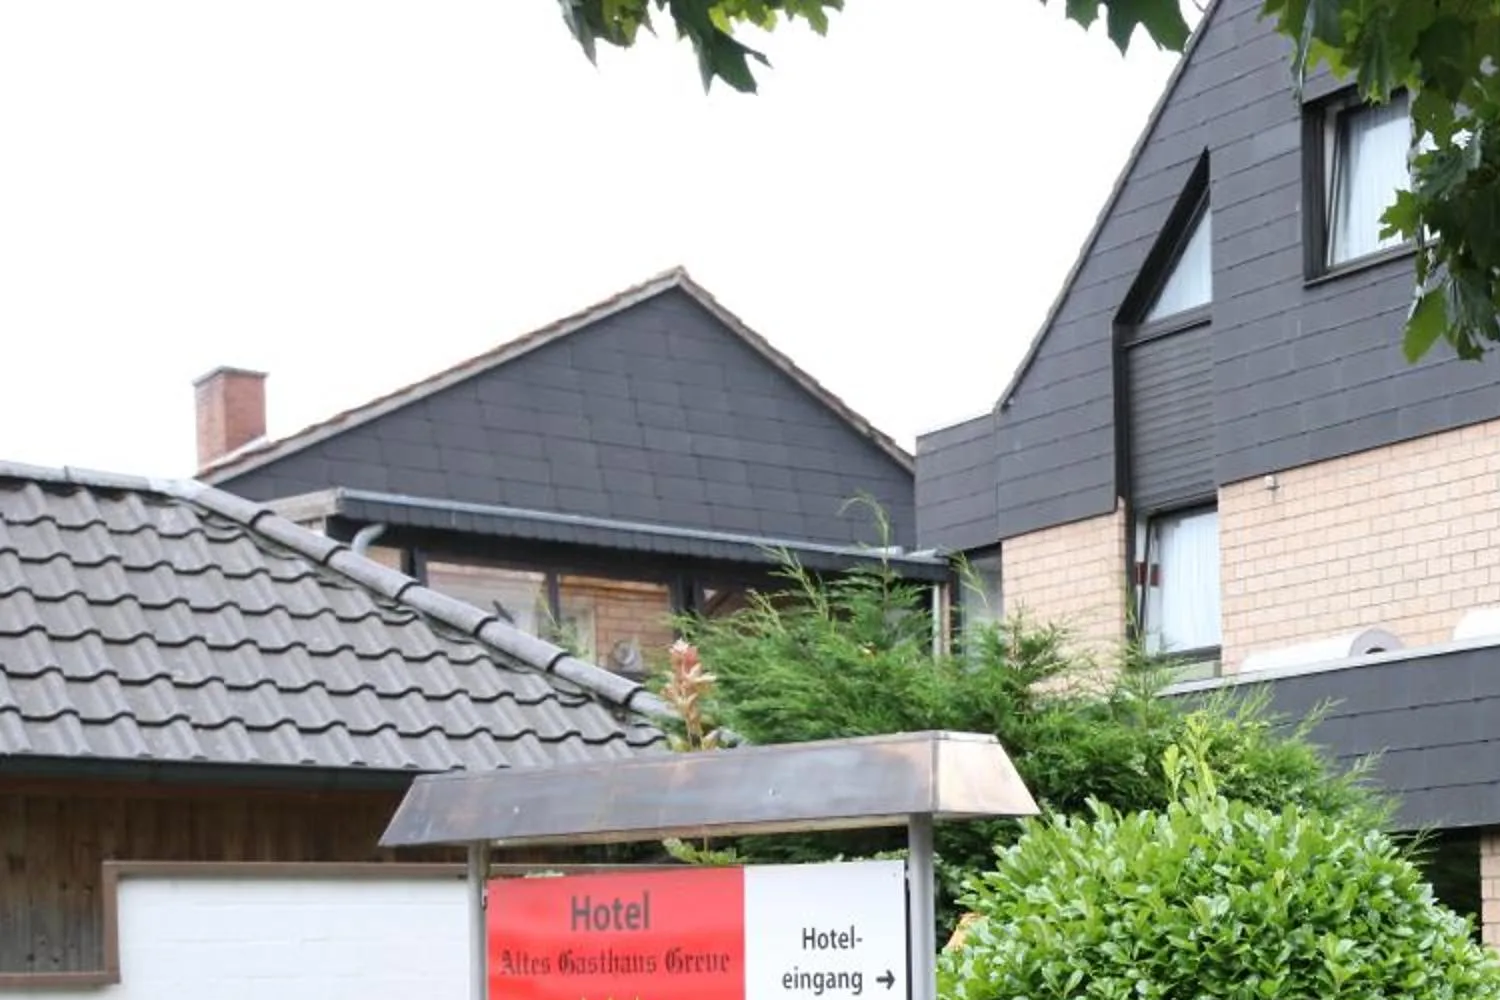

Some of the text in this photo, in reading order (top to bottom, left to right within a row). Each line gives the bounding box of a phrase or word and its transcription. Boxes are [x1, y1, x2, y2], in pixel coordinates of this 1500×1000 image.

[570, 891, 651, 931] Hotel
[802, 926, 863, 950] Hotel-
[500, 946, 730, 977] Altes Gasthaus Greve
[782, 966, 863, 996] eingang
